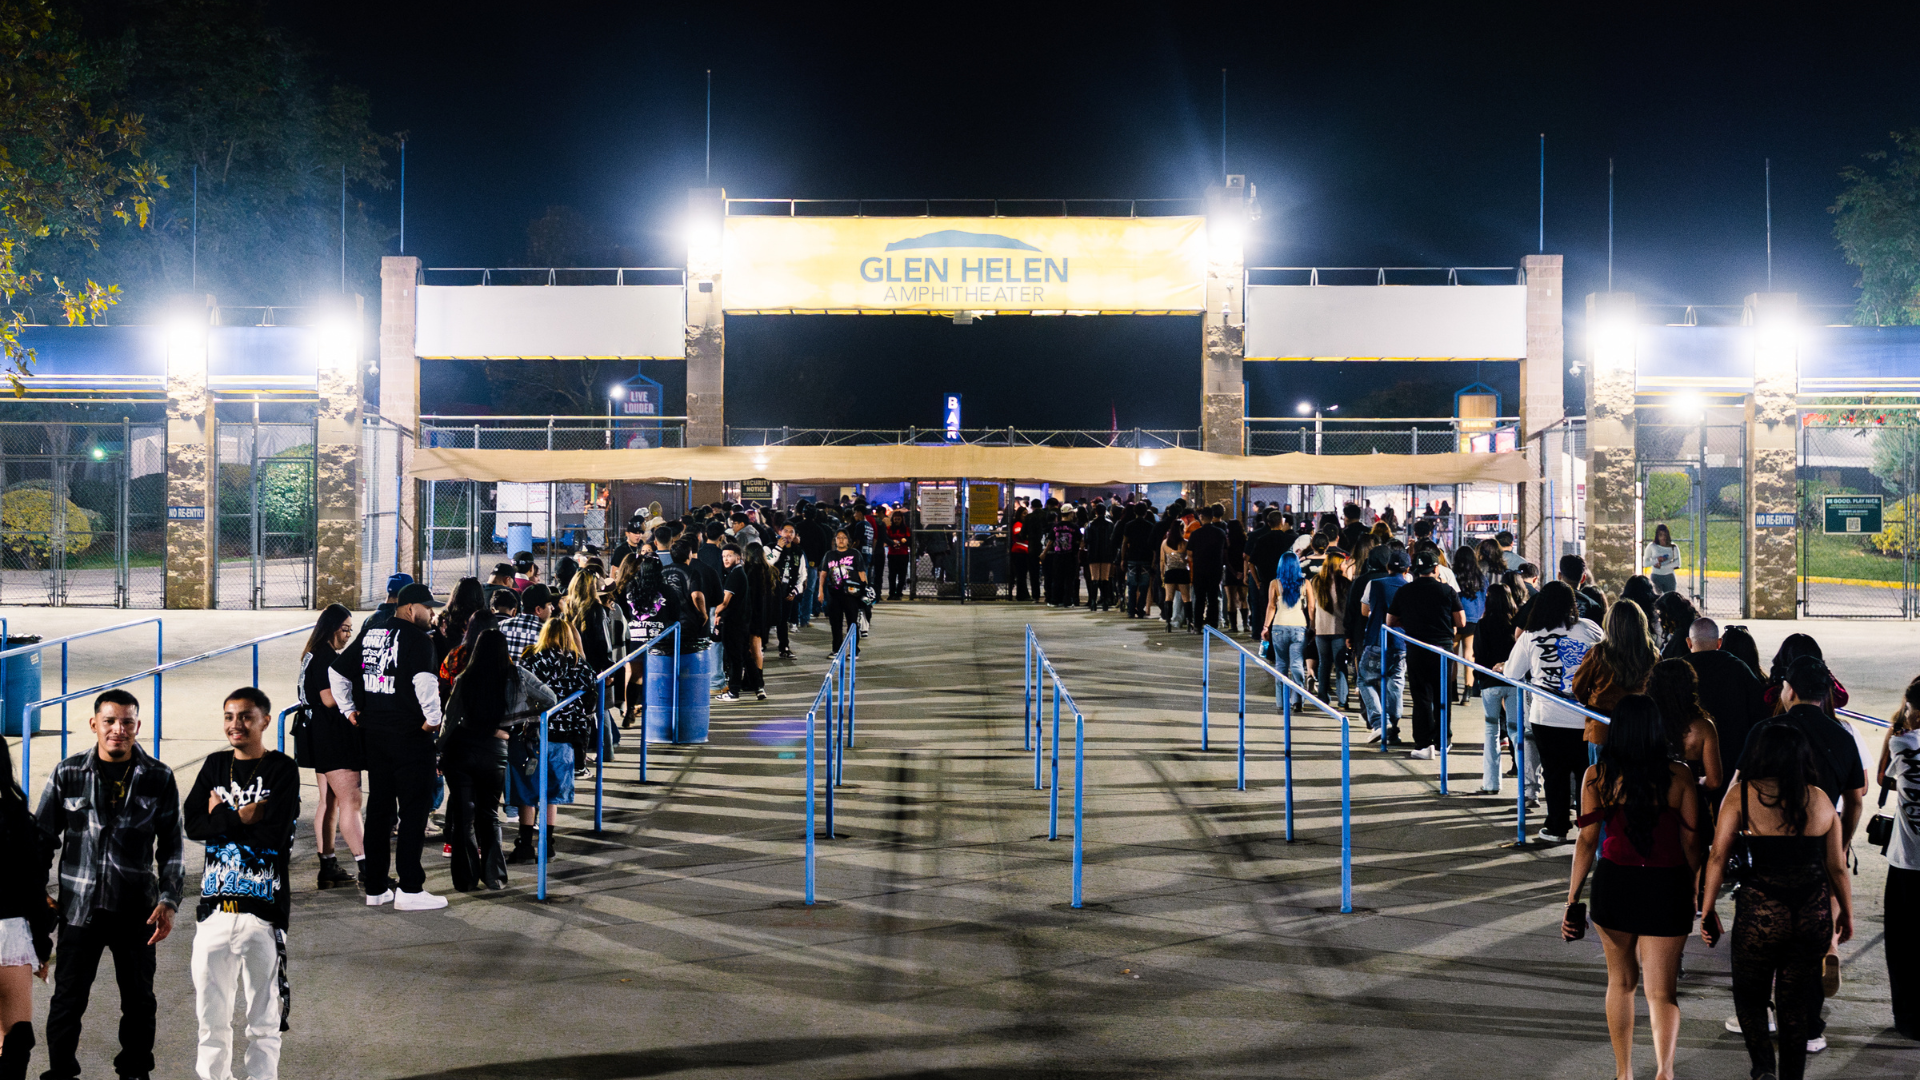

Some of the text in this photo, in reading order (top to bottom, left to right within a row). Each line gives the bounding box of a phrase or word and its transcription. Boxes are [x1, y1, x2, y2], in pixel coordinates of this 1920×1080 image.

[860, 257, 1069, 283] GLEN HELEN
[883, 286, 1044, 302] AMPHITHEATER
[629, 391, 649, 402] LIVE
[624, 402, 655, 414] LOUDER
[946, 396, 958, 439] BAR
[169, 508, 203, 518] NO RE-ENTRY
[1756, 515, 1795, 525] NO RE-ENTRY
[220, 869, 275, 902] Azul
